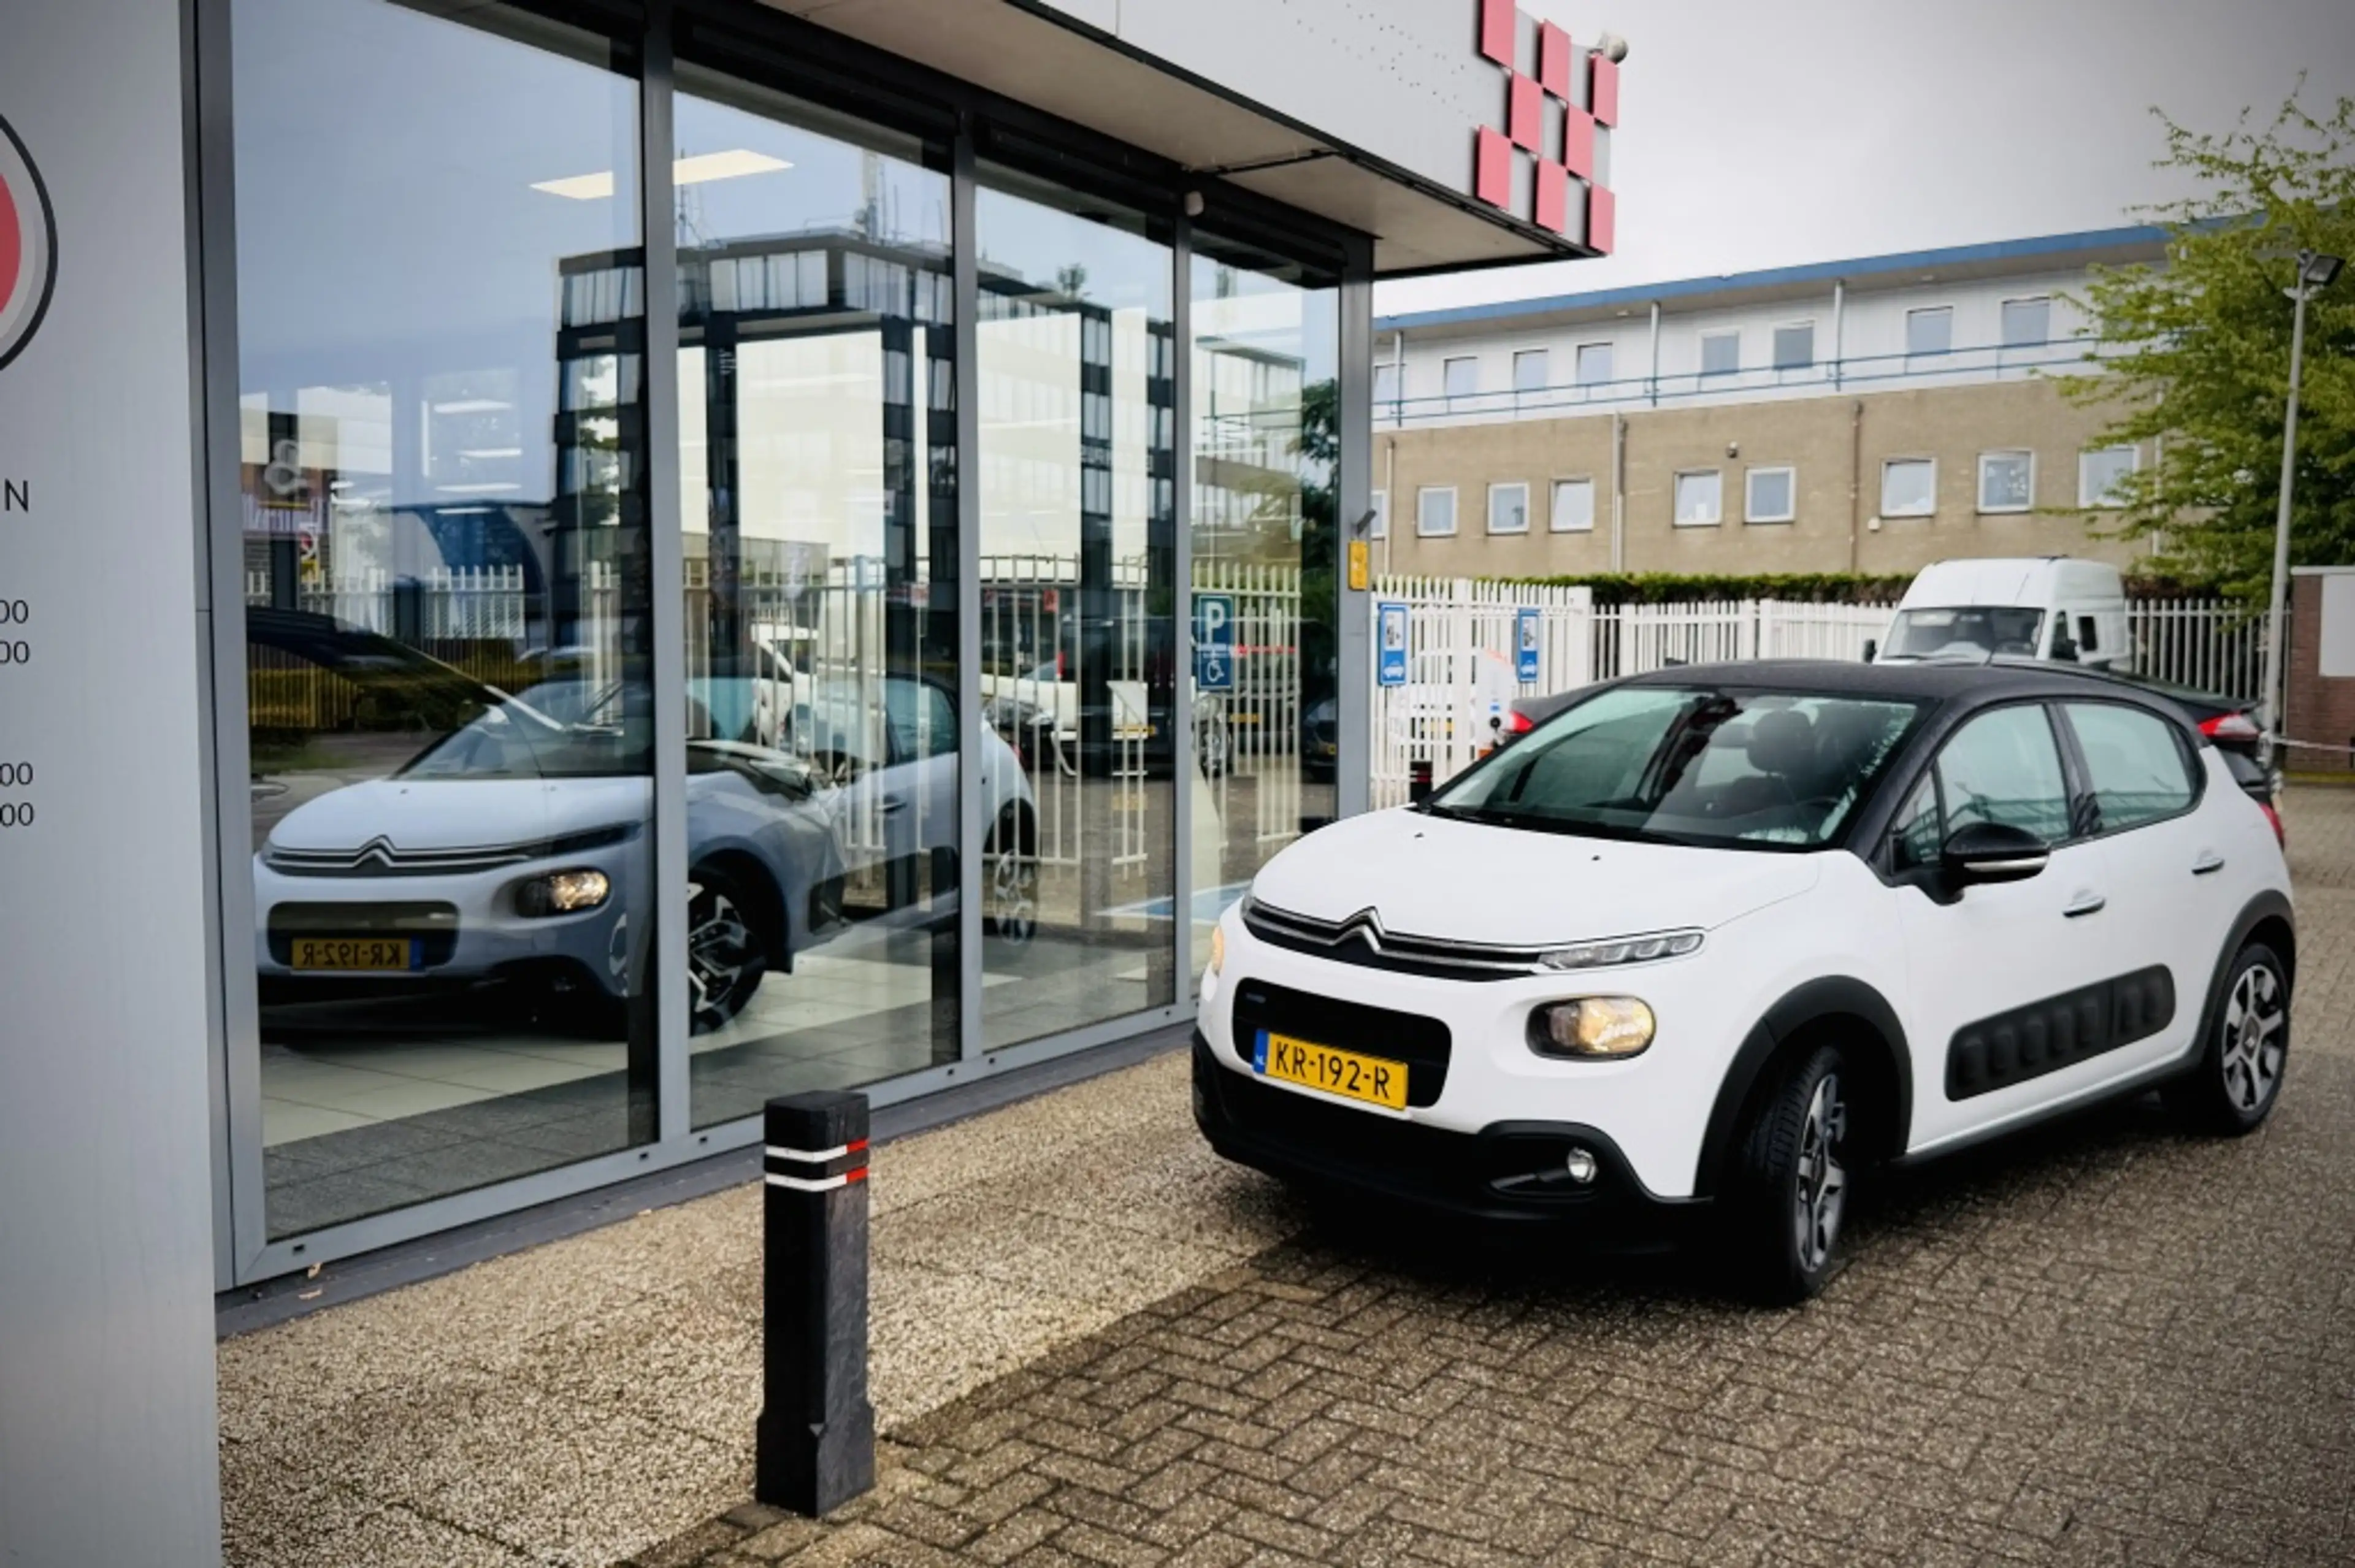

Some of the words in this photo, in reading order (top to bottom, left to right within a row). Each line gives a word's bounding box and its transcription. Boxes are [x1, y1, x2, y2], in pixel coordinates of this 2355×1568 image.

[5, 478, 29, 514] N
[1205, 601, 1225, 644] P
[0, 762, 34, 787] 00
[0, 803, 34, 828] 00
[1276, 1041, 1390, 1100] KR-192-R
